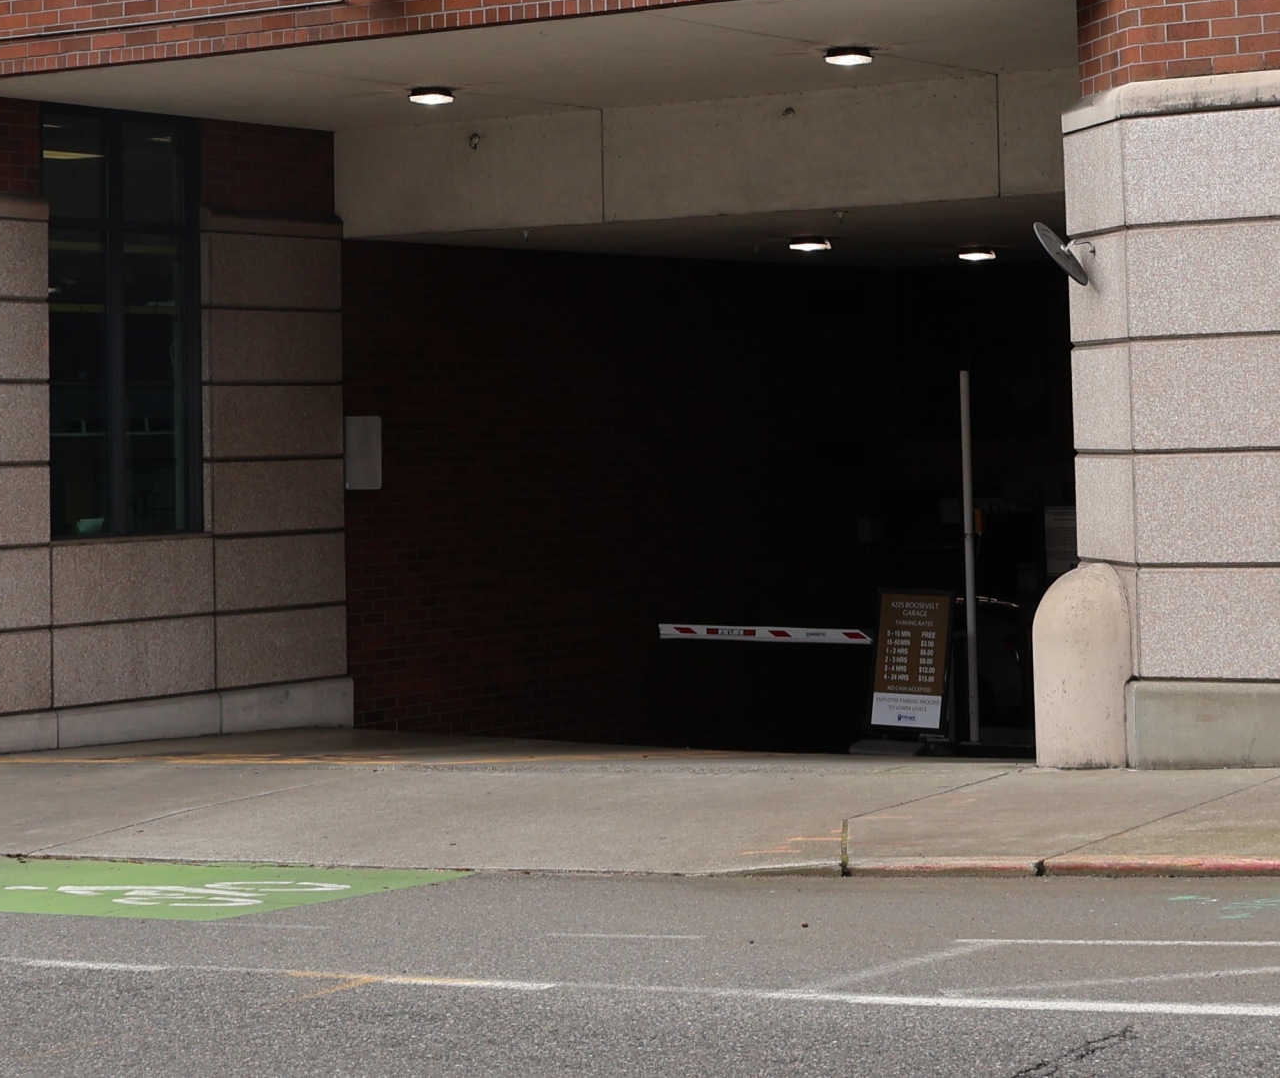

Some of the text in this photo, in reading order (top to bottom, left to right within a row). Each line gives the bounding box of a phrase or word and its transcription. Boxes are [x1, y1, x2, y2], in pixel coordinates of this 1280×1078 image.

[891, 601, 940, 610] 4225 ROOSEVELT
[921, 631, 936, 639] FREE
[920, 640, 934, 648] $3.00
[918, 666, 935, 674] $12.00
[918, 675, 935, 683] $15.00
